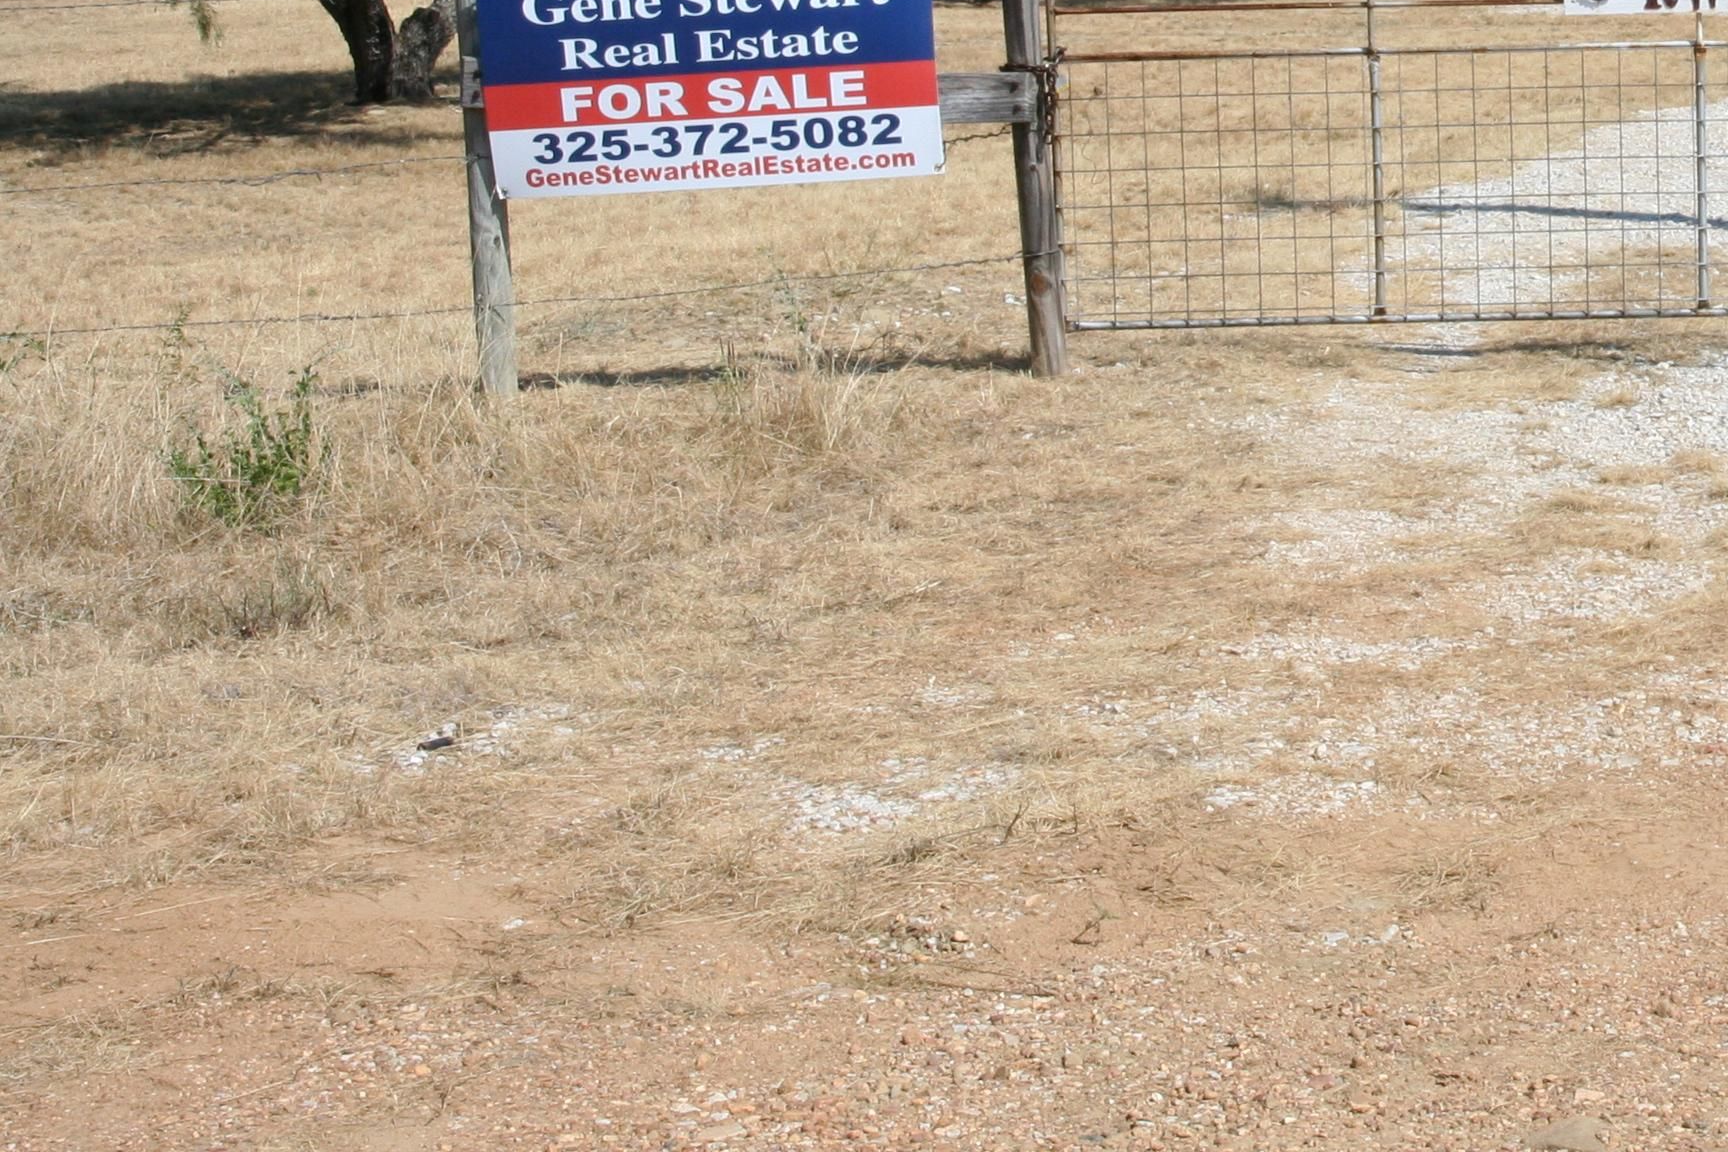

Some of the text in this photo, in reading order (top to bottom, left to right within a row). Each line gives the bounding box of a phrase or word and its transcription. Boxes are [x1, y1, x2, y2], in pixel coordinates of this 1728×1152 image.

[560, 25, 859, 70] Real Estate
[560, 70, 867, 122] FOR SALE
[532, 114, 902, 164] 325-372-5082
[526, 152, 915, 188] GeneStewartRealEstate.com
